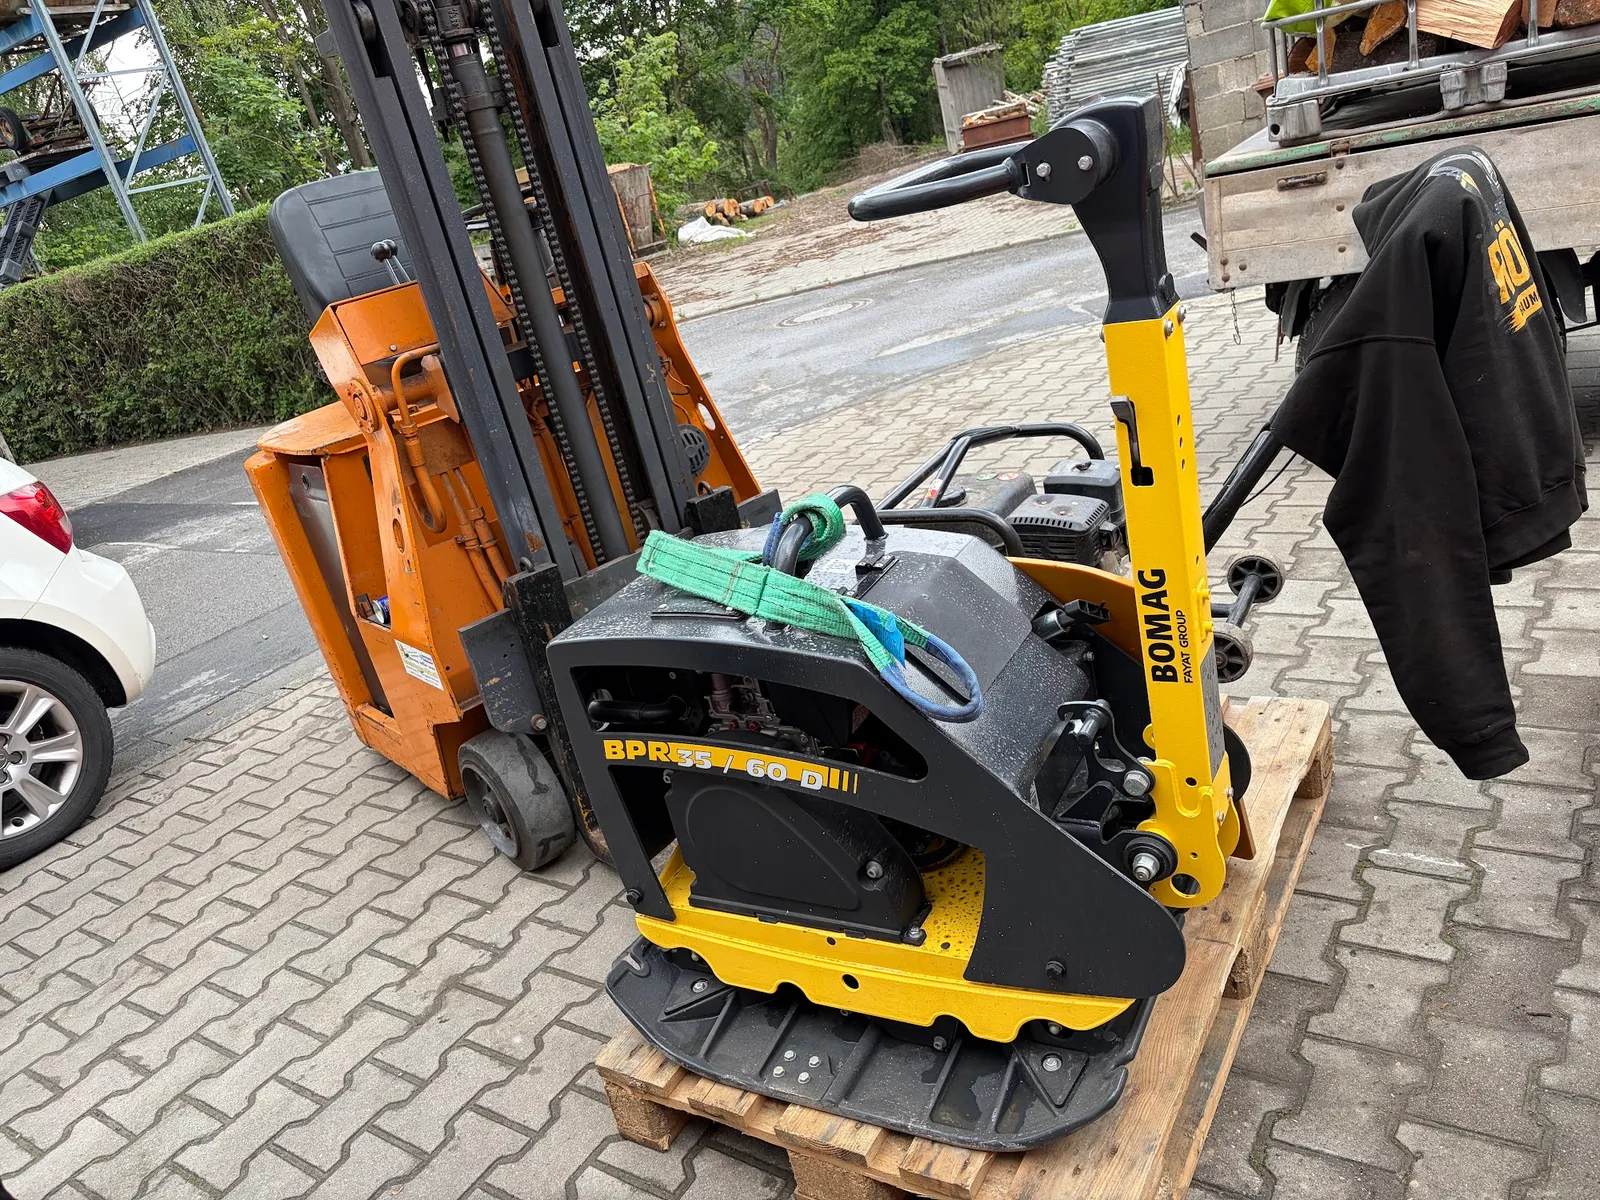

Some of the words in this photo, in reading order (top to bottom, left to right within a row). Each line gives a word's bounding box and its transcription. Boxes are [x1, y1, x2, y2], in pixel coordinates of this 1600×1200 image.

[1137, 569, 1178, 682] BOMAG
[1176, 610, 1188, 648] GROUP
[1181, 651, 1193, 683] FAYAT
[603, 739, 670, 762] BPR
[676, 749, 713, 770] 35
[745, 759, 788, 782] 60
[800, 769, 824, 791] D
